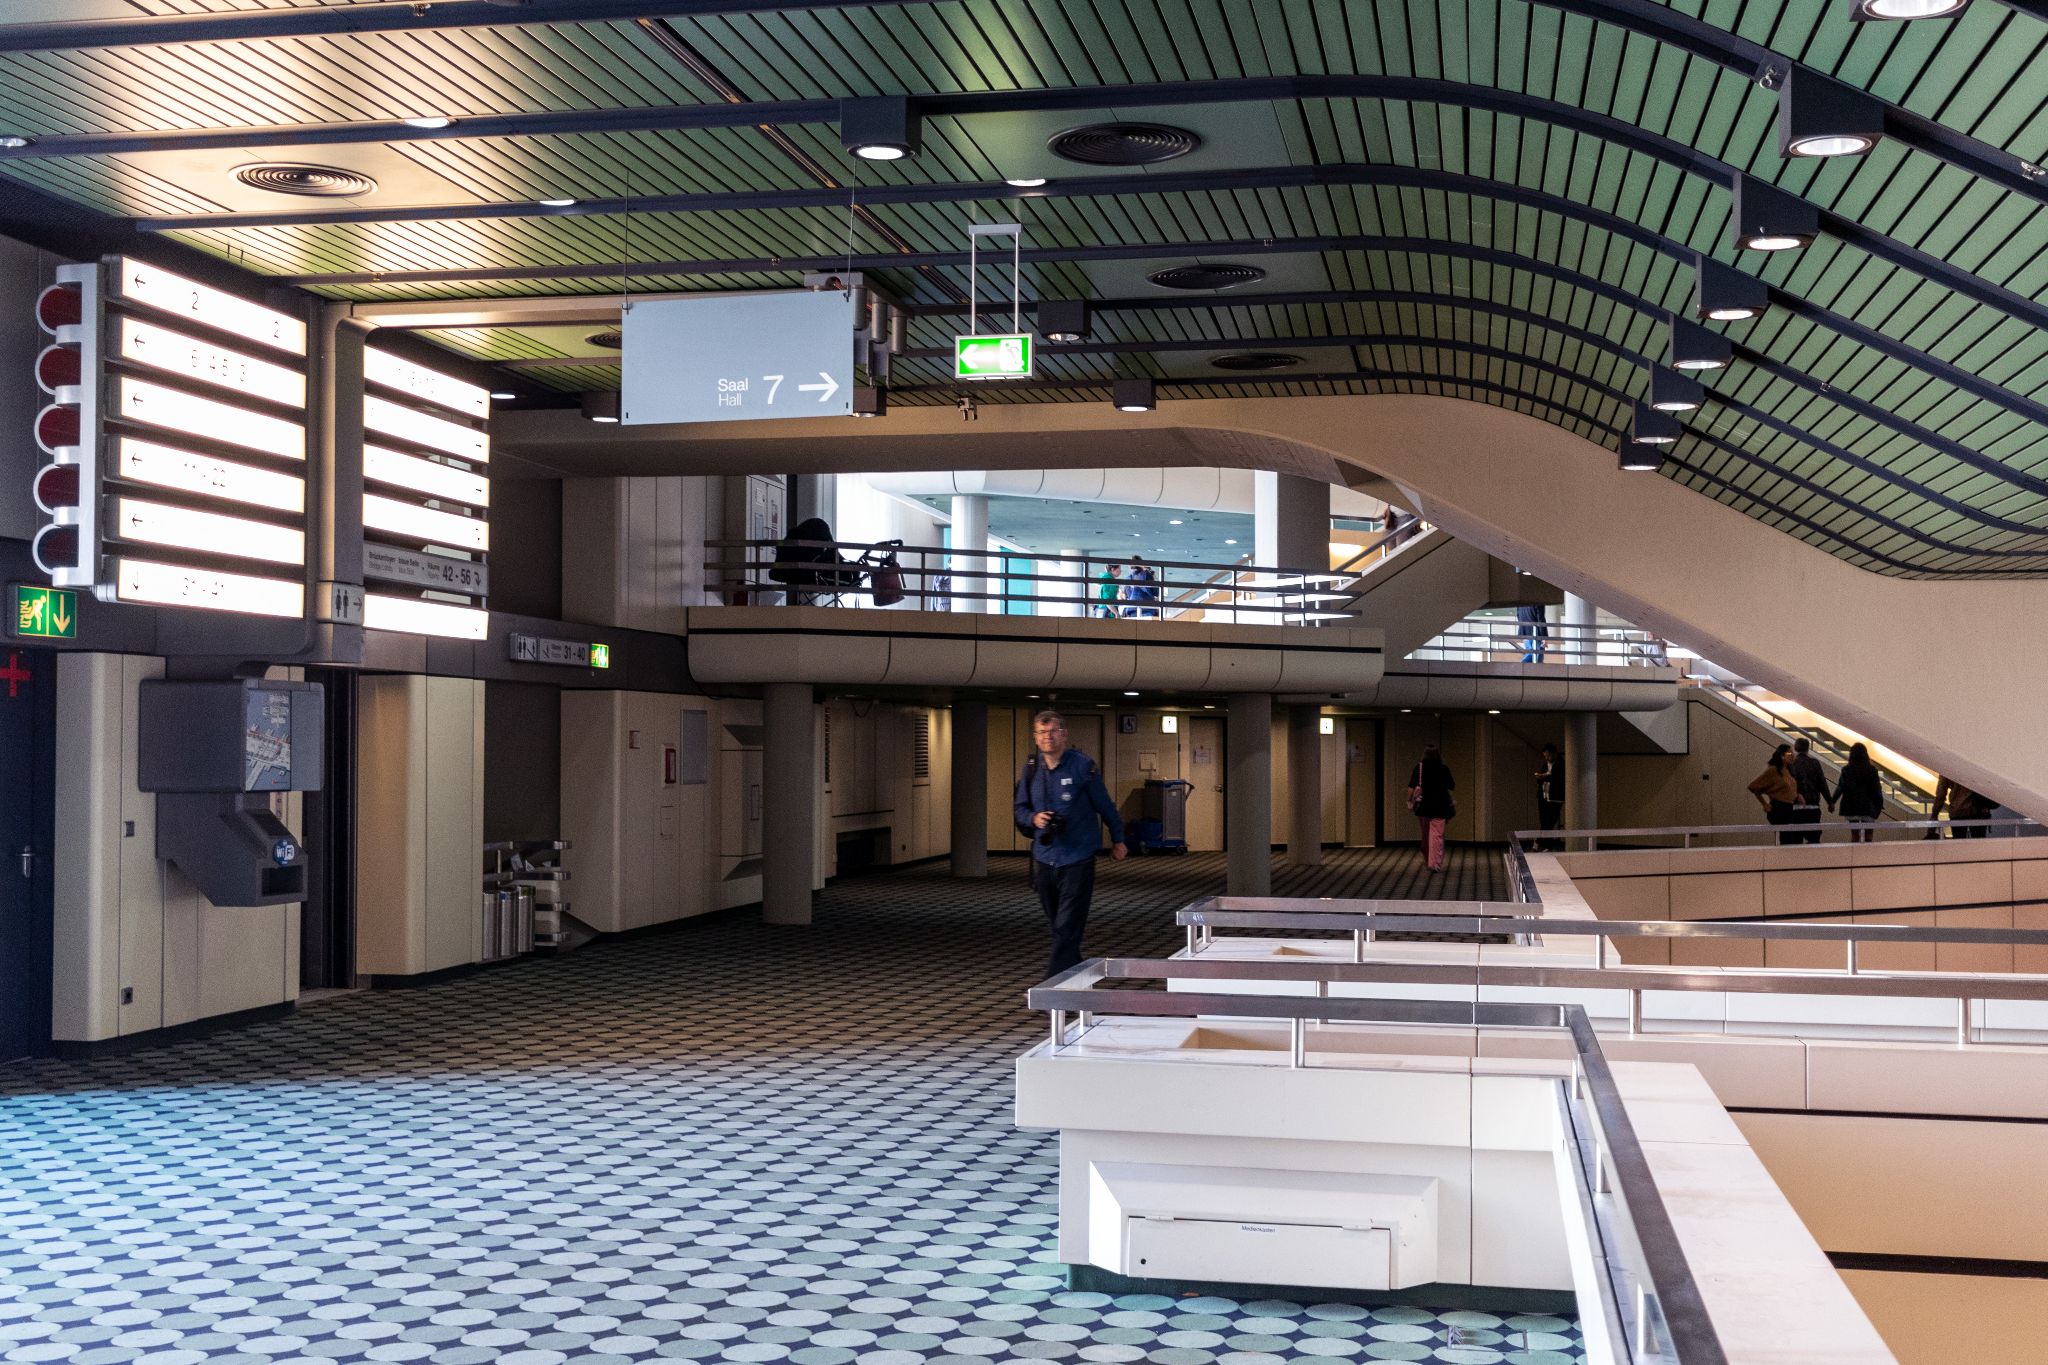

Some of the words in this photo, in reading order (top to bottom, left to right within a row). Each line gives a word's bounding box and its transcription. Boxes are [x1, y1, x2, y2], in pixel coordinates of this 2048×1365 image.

[191, 291, 199, 311] 2
[717, 377, 749, 392] Saal
[762, 374, 784, 405] 7
[718, 392, 742, 407] Hall
